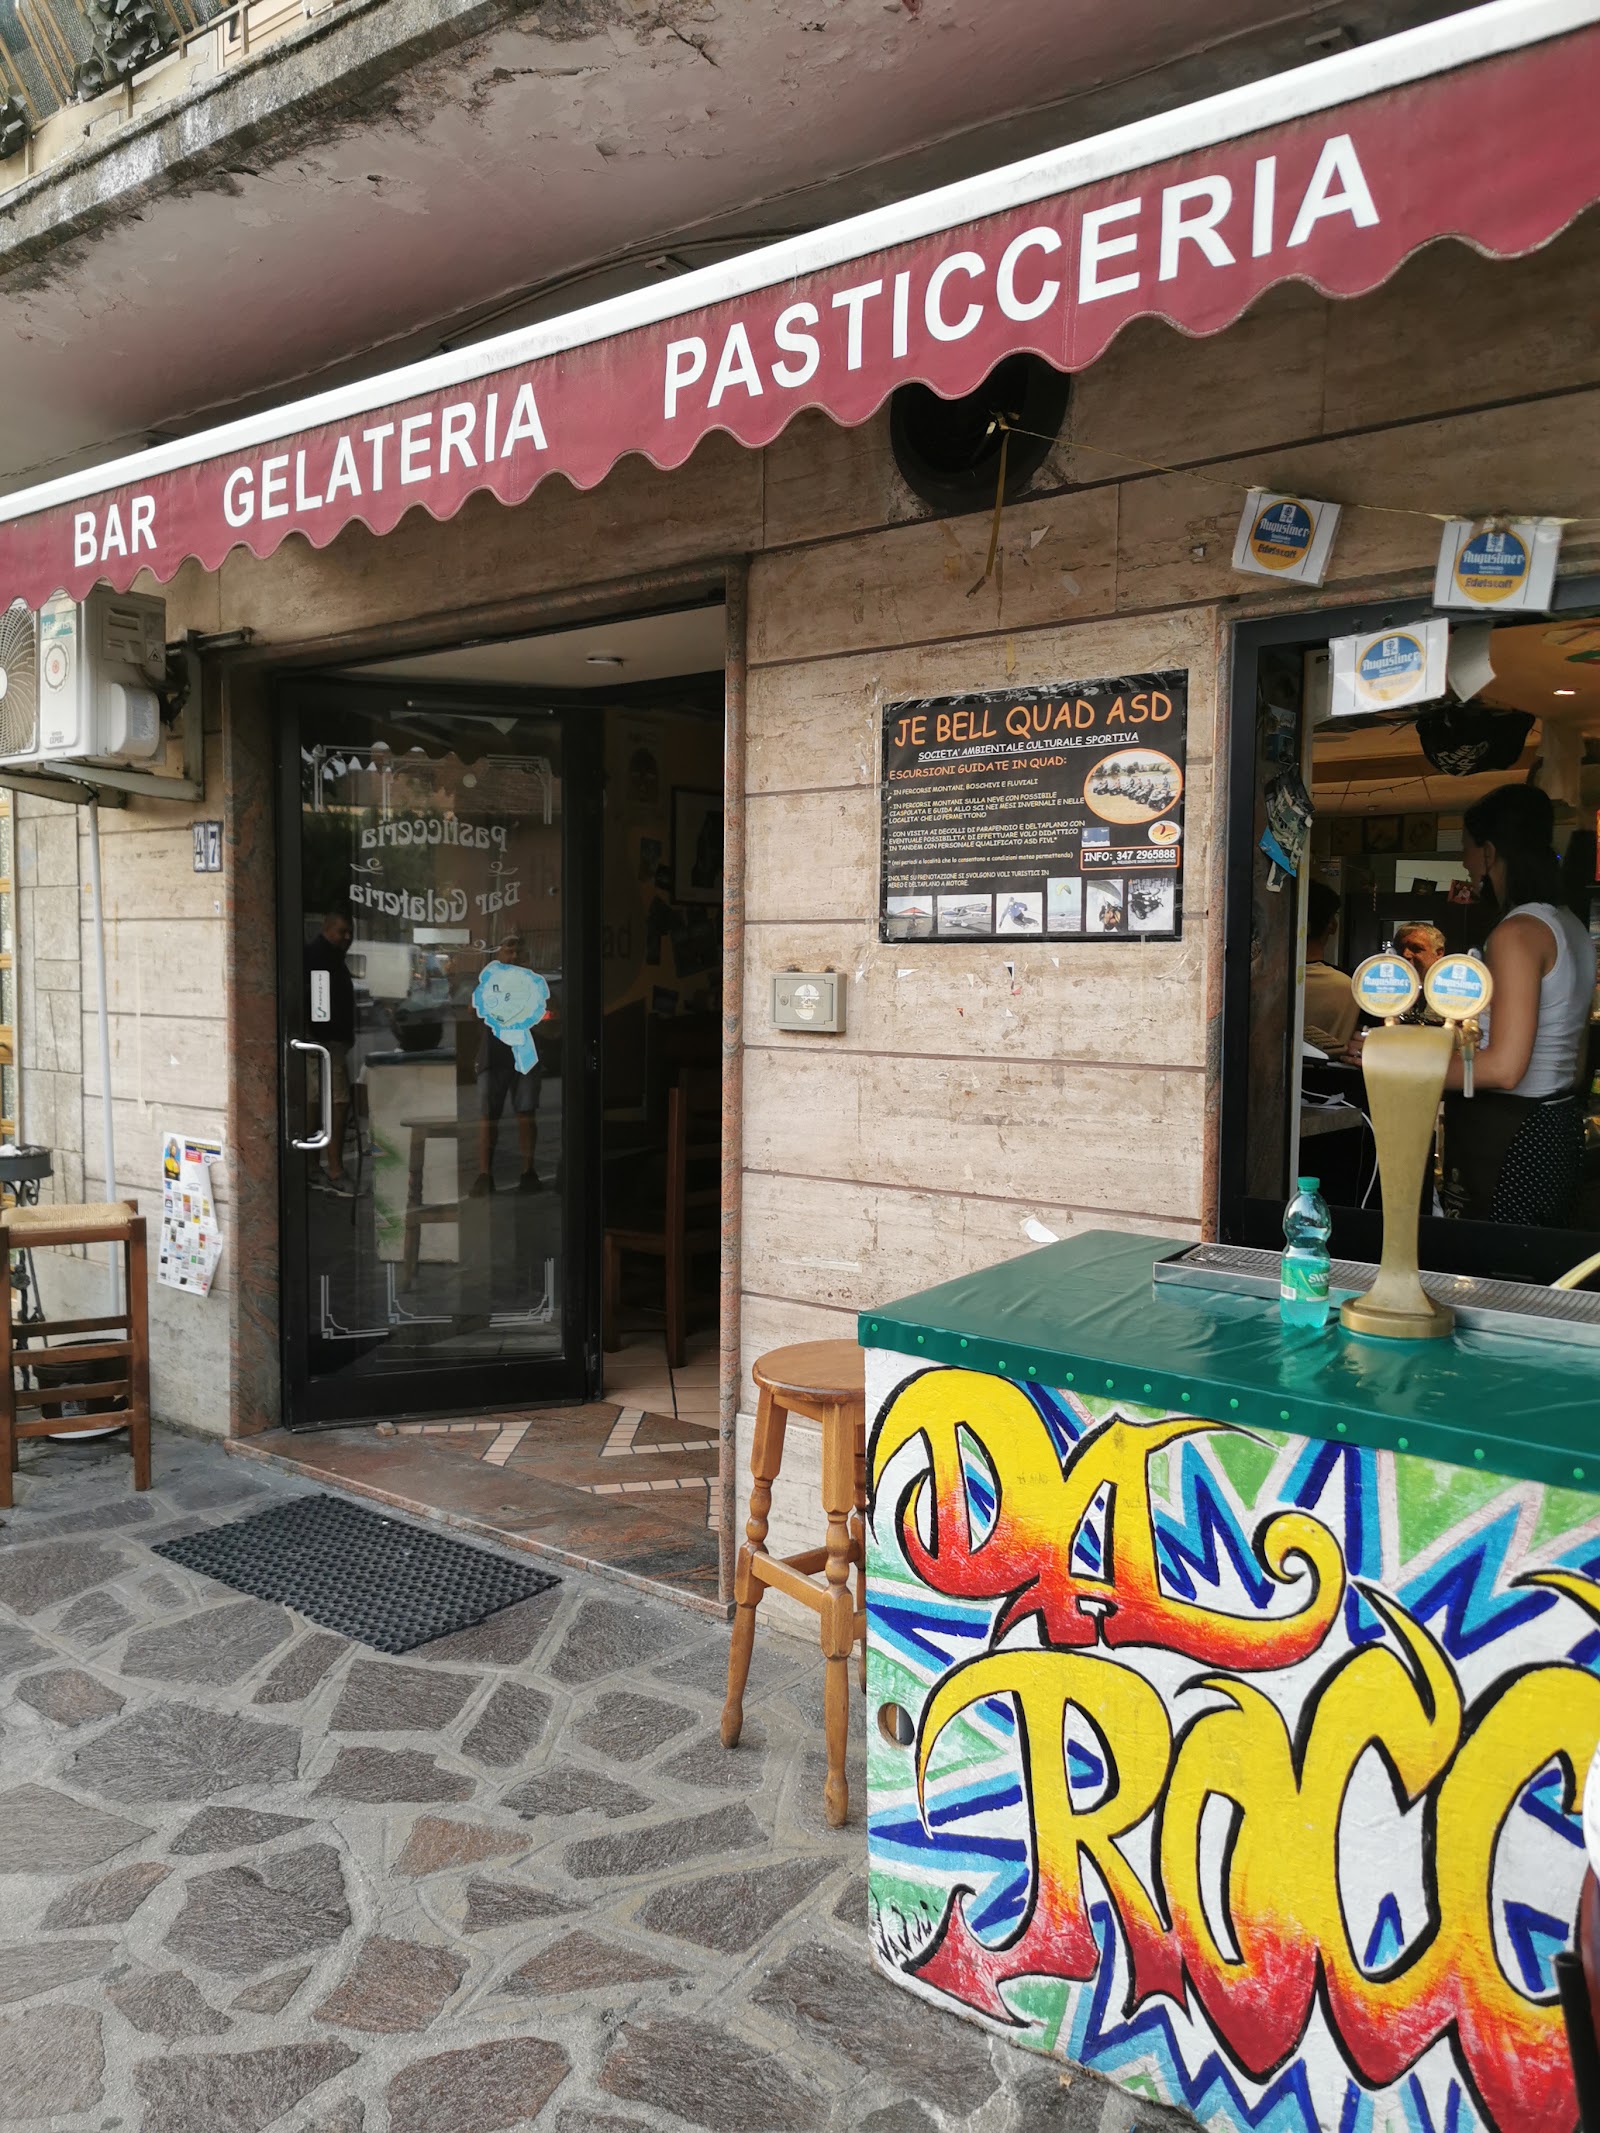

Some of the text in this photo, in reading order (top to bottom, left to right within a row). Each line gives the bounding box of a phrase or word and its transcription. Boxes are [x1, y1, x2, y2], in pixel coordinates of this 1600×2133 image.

[73, 133, 1381, 567] BAR GELATERIA PASTICCERIA
[1259, 518, 1310, 537] Augustiner
[1463, 550, 1526, 565] Augustiner
[1362, 651, 1421, 671] Augustiner
[894, 690, 1173, 747] JE BELL QUAD ASD
[918, 731, 1139, 761] SOCIETA' AMBIENTALE CULTURALE SPORTIVA
[889, 756, 1068, 781] ESCURSIONI GUIDATE IN QUAD:
[902, 786, 931, 795] PERCORSI
[966, 781, 1000, 790] BOSCHIVI
[1007, 779, 1039, 787] FLUVIALI
[902, 800, 931, 809] PERCORSI
[1005, 794, 1019, 802] CON
[1020, 792, 1057, 801] POSSIBILE
[985, 803, 998, 811] NEI
[999, 801, 1016, 809] MESI
[1017, 799, 1056, 808] INVERNALI
[1062, 797, 1085, 805] NELLE
[942, 812, 987, 821] PERMETTONO
[889, 837, 923, 845] EVENTUALE
[976, 832, 1018, 840] EFFETTUARE
[1038, 828, 1078, 836] DIDATTICO
[892, 830, 906, 838] CON
[906, 828, 928, 836] VISITA
[938, 827, 965, 835] DECOLLI
[976, 824, 1018, 832] PARAPENDIO
[1025, 821, 1068, 830] DELTAPLANO
[938, 841, 974, 849] PERSONALE
[975, 839, 1023, 848] QUALIFICATO
[1084, 849, 1176, 862] INFO: 347 2965888
[1011, 869, 1040, 877] TURISTICI
